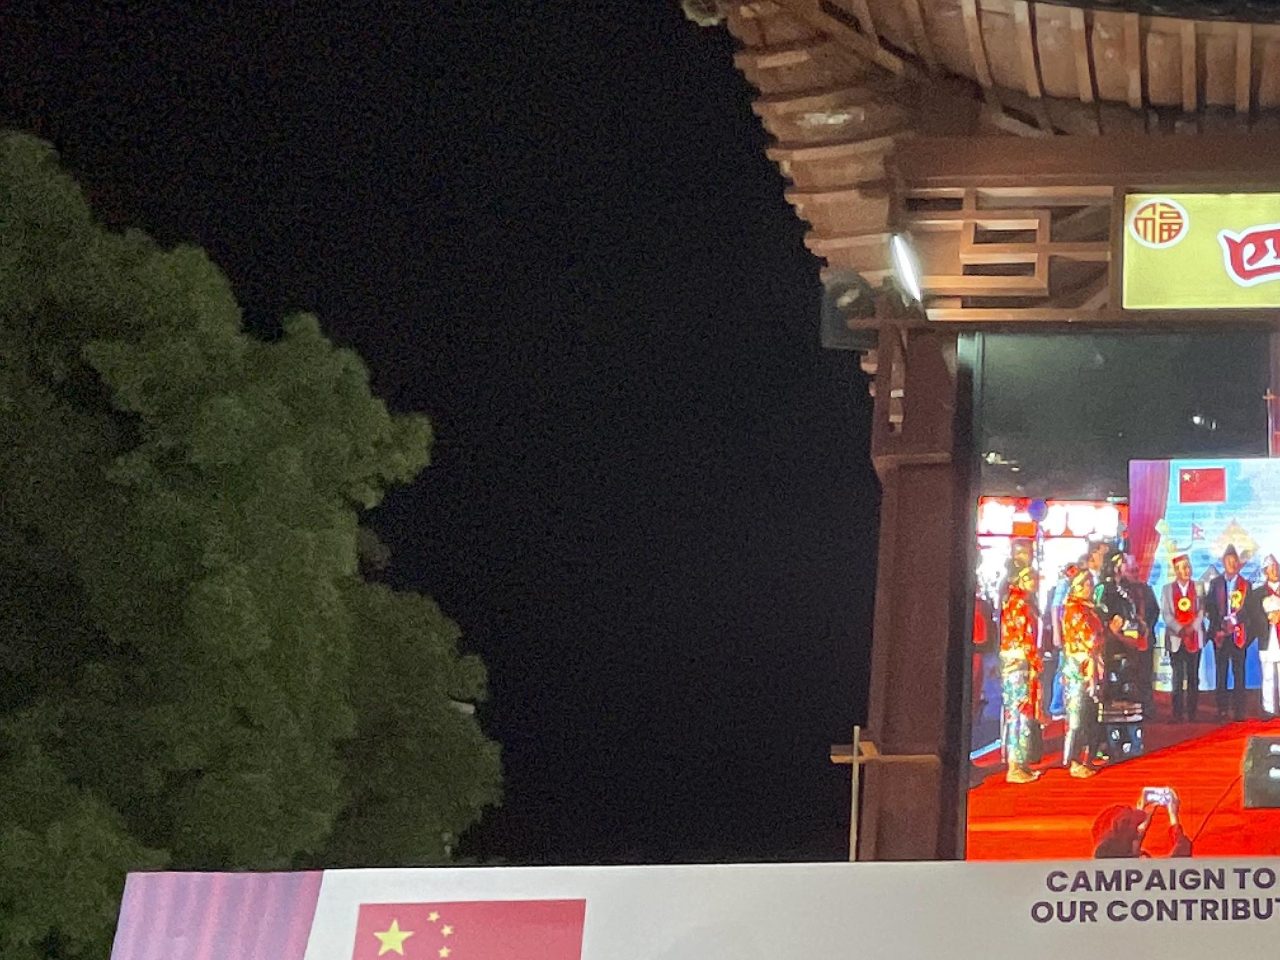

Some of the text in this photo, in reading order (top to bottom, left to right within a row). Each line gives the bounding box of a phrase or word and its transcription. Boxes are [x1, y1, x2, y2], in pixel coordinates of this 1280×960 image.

[1046, 867, 1226, 892] CAMPAIGN
[1233, 867, 1276, 890] TO
[1031, 900, 1098, 923] OUR
